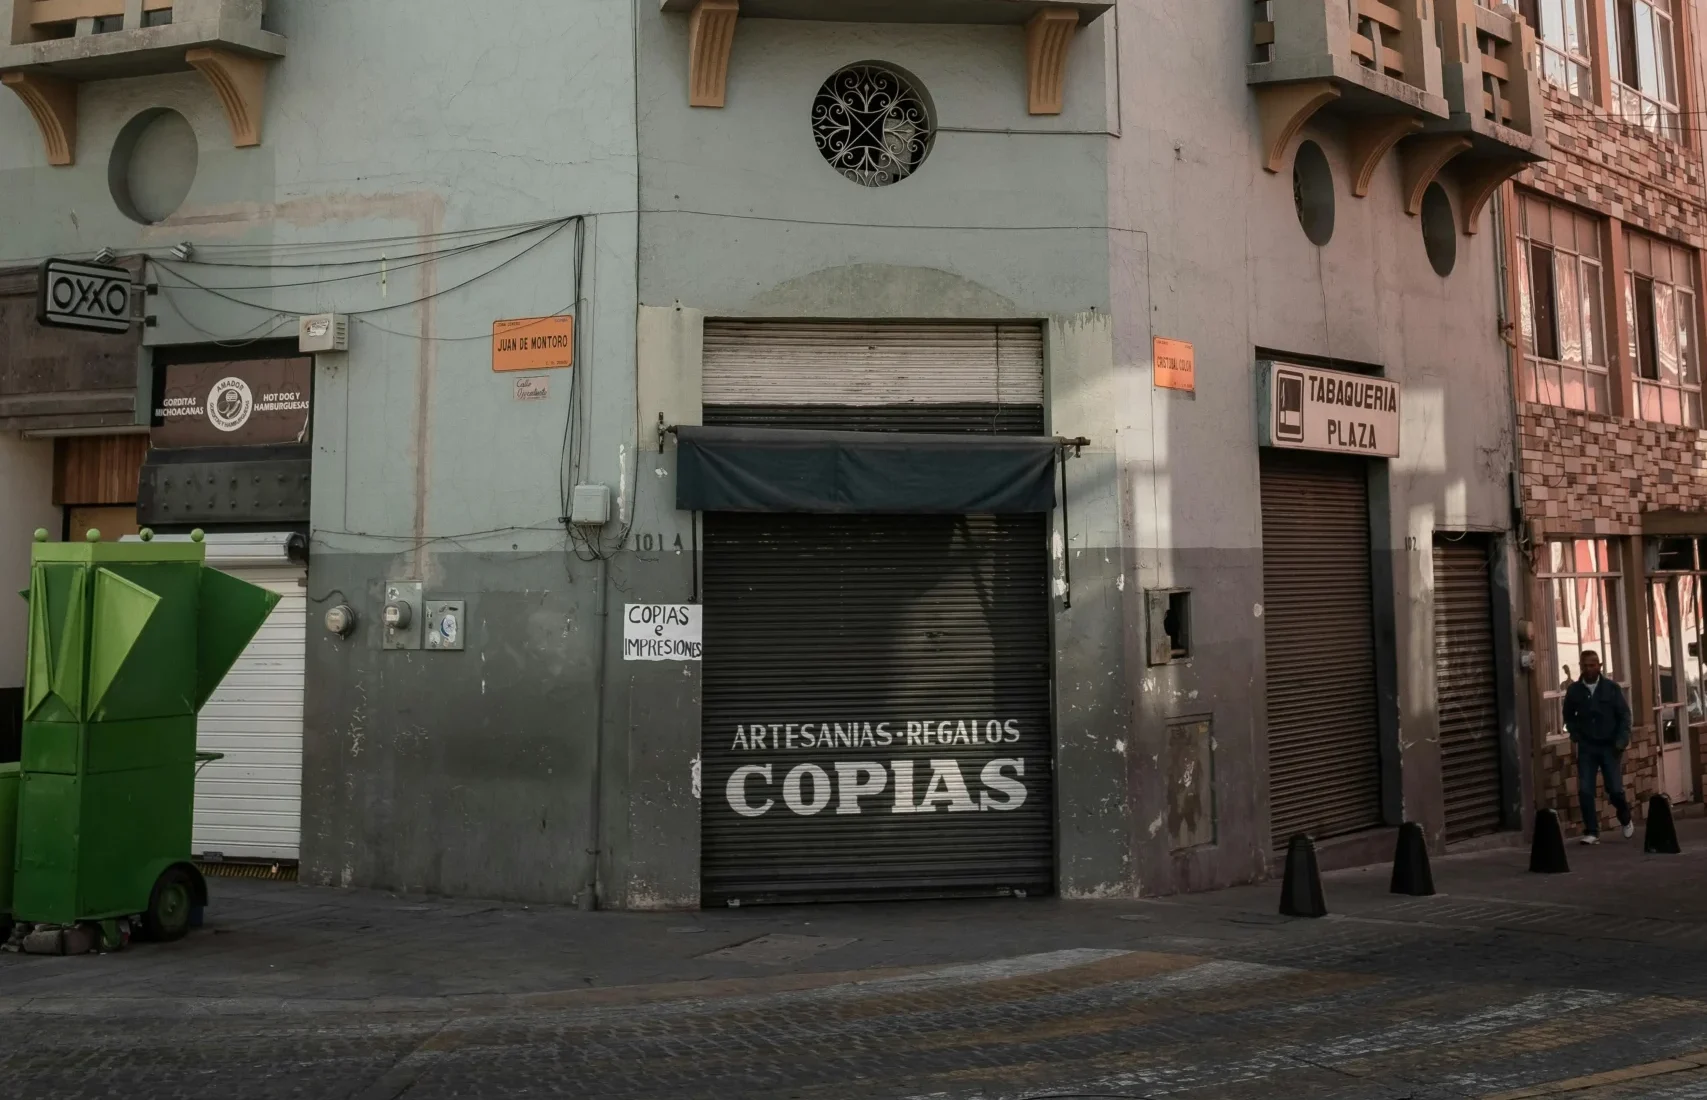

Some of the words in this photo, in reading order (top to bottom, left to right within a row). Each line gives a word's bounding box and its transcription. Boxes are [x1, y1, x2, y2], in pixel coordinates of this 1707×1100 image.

[52, 276, 127, 316] OXXO
[497, 338, 517, 352] JUAN
[519, 337, 528, 350] DE
[531, 335, 568, 350] MONTORO
[216, 380, 245, 392] AMADOR
[163, 397, 197, 407] GORDITAS
[263, 393, 278, 402] HOT
[279, 392, 295, 401] DOG
[295, 392, 300, 400] Y
[155, 406, 204, 417] MICHOACANAS
[253, 401, 309, 412] HAMBURGUESAS
[1327, 419, 1377, 450] PLAZA
[635, 533, 663, 552] 101
[673, 532, 684, 550] A
[628, 605, 690, 625] COPIAS
[654, 624, 664, 637] e
[624, 638, 702, 658] IMPRESIONES
[731, 722, 893, 751] ARTESANIAS
[906, 719, 1021, 746] REGALOS
[725, 757, 1028, 817] COPIAS
